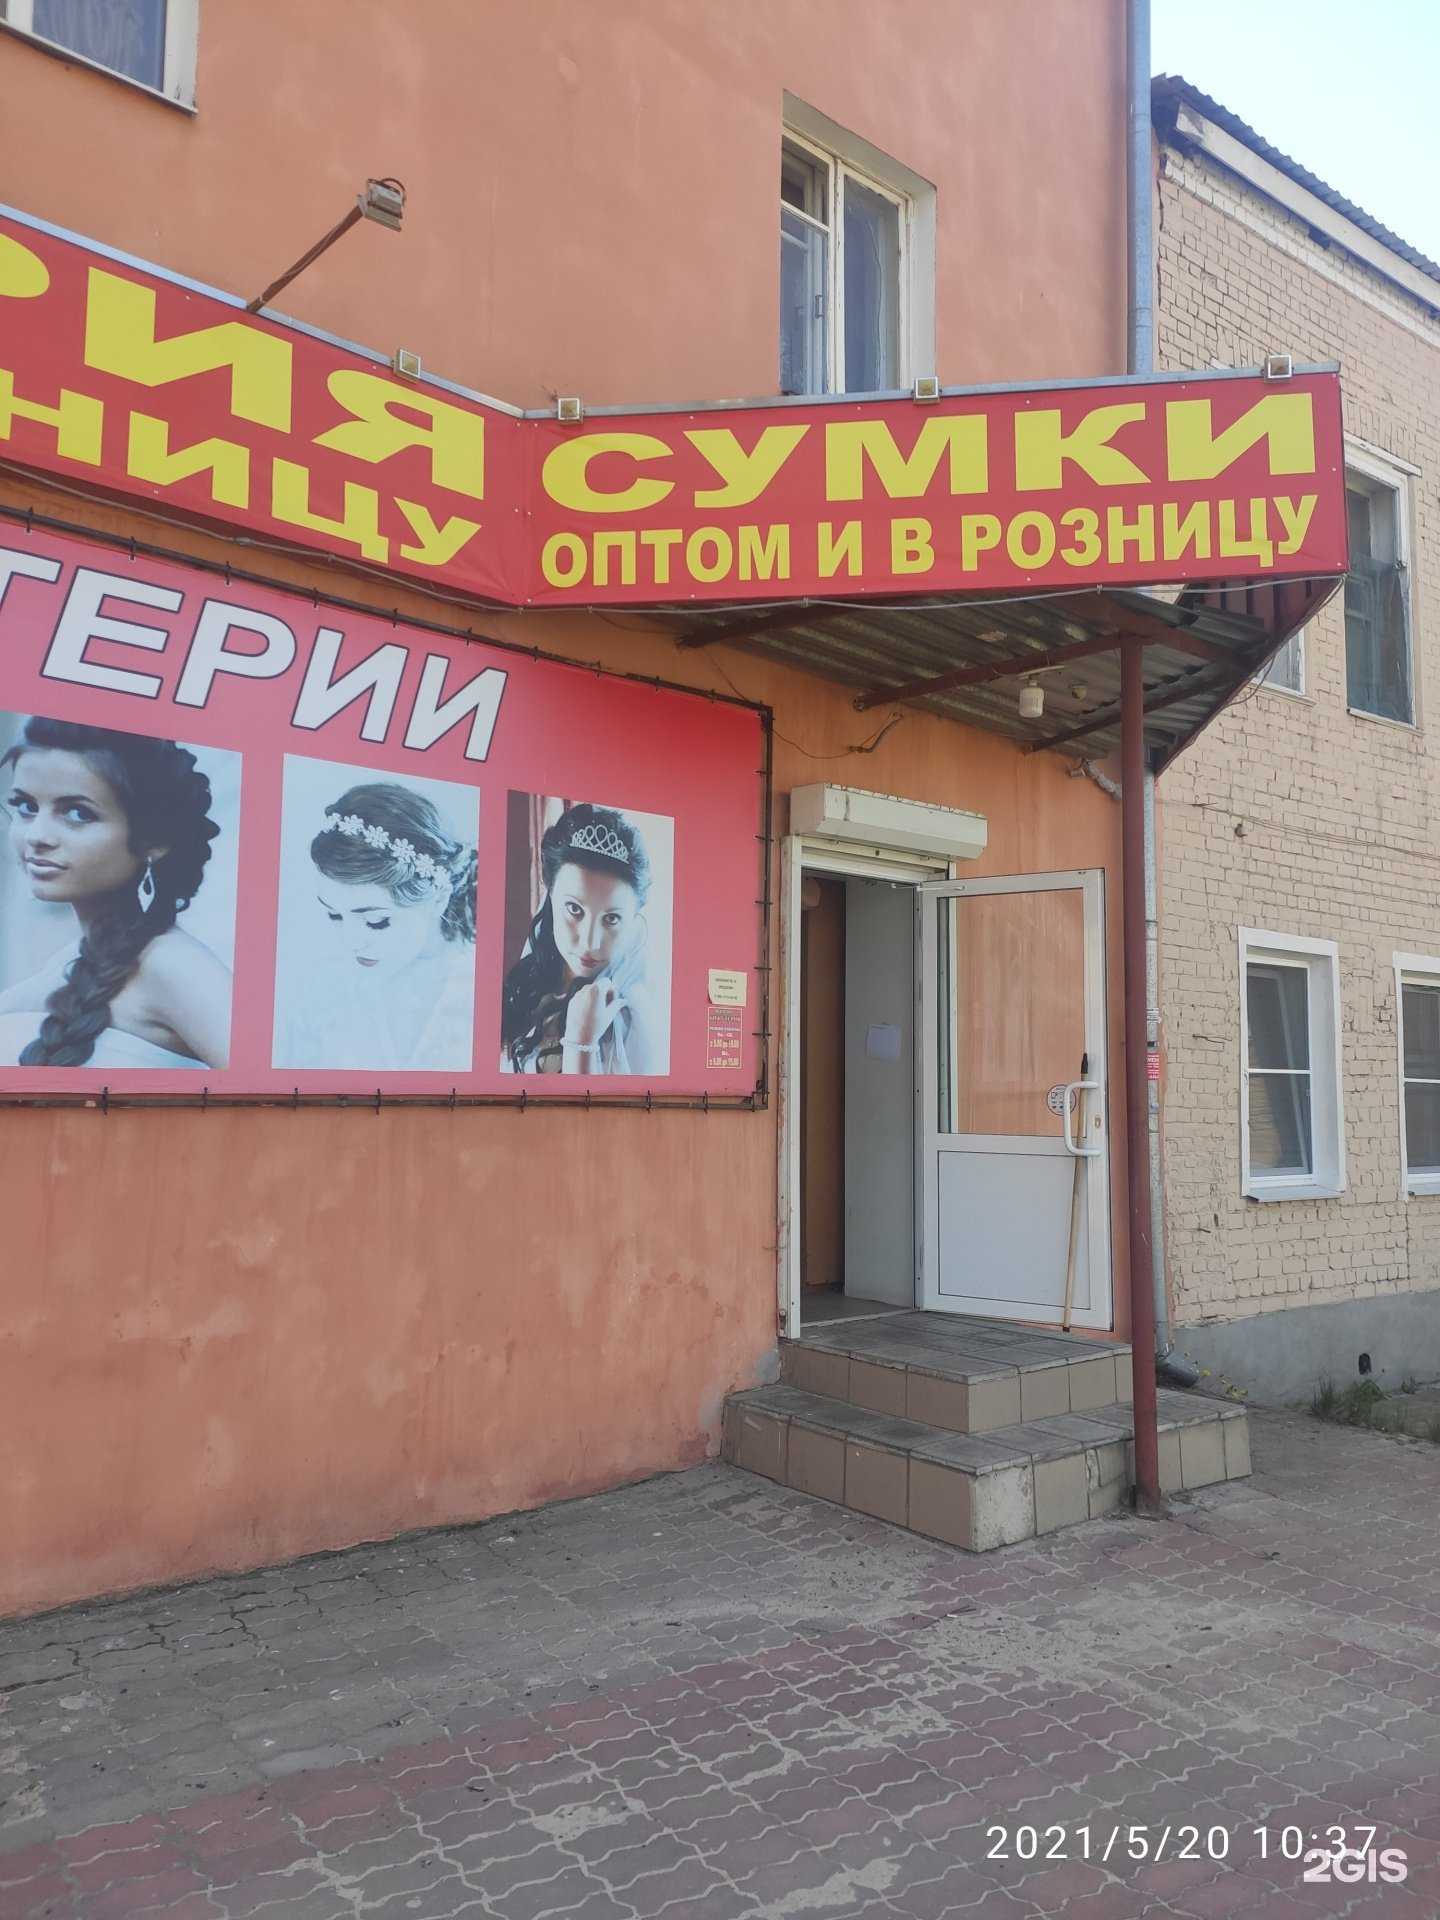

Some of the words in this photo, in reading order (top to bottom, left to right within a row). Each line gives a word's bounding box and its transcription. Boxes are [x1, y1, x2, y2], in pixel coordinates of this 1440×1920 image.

[0, 232, 485, 500] ИЯ
[0, 367, 482, 566] НИЦУ
[541, 393, 1316, 513] СУМКИ
[541, 522, 791, 588] ОПТОМ
[817, 520, 863, 578] И
[891, 516, 936, 575] В
[960, 494, 1318, 571] РОЗНИЦУ
